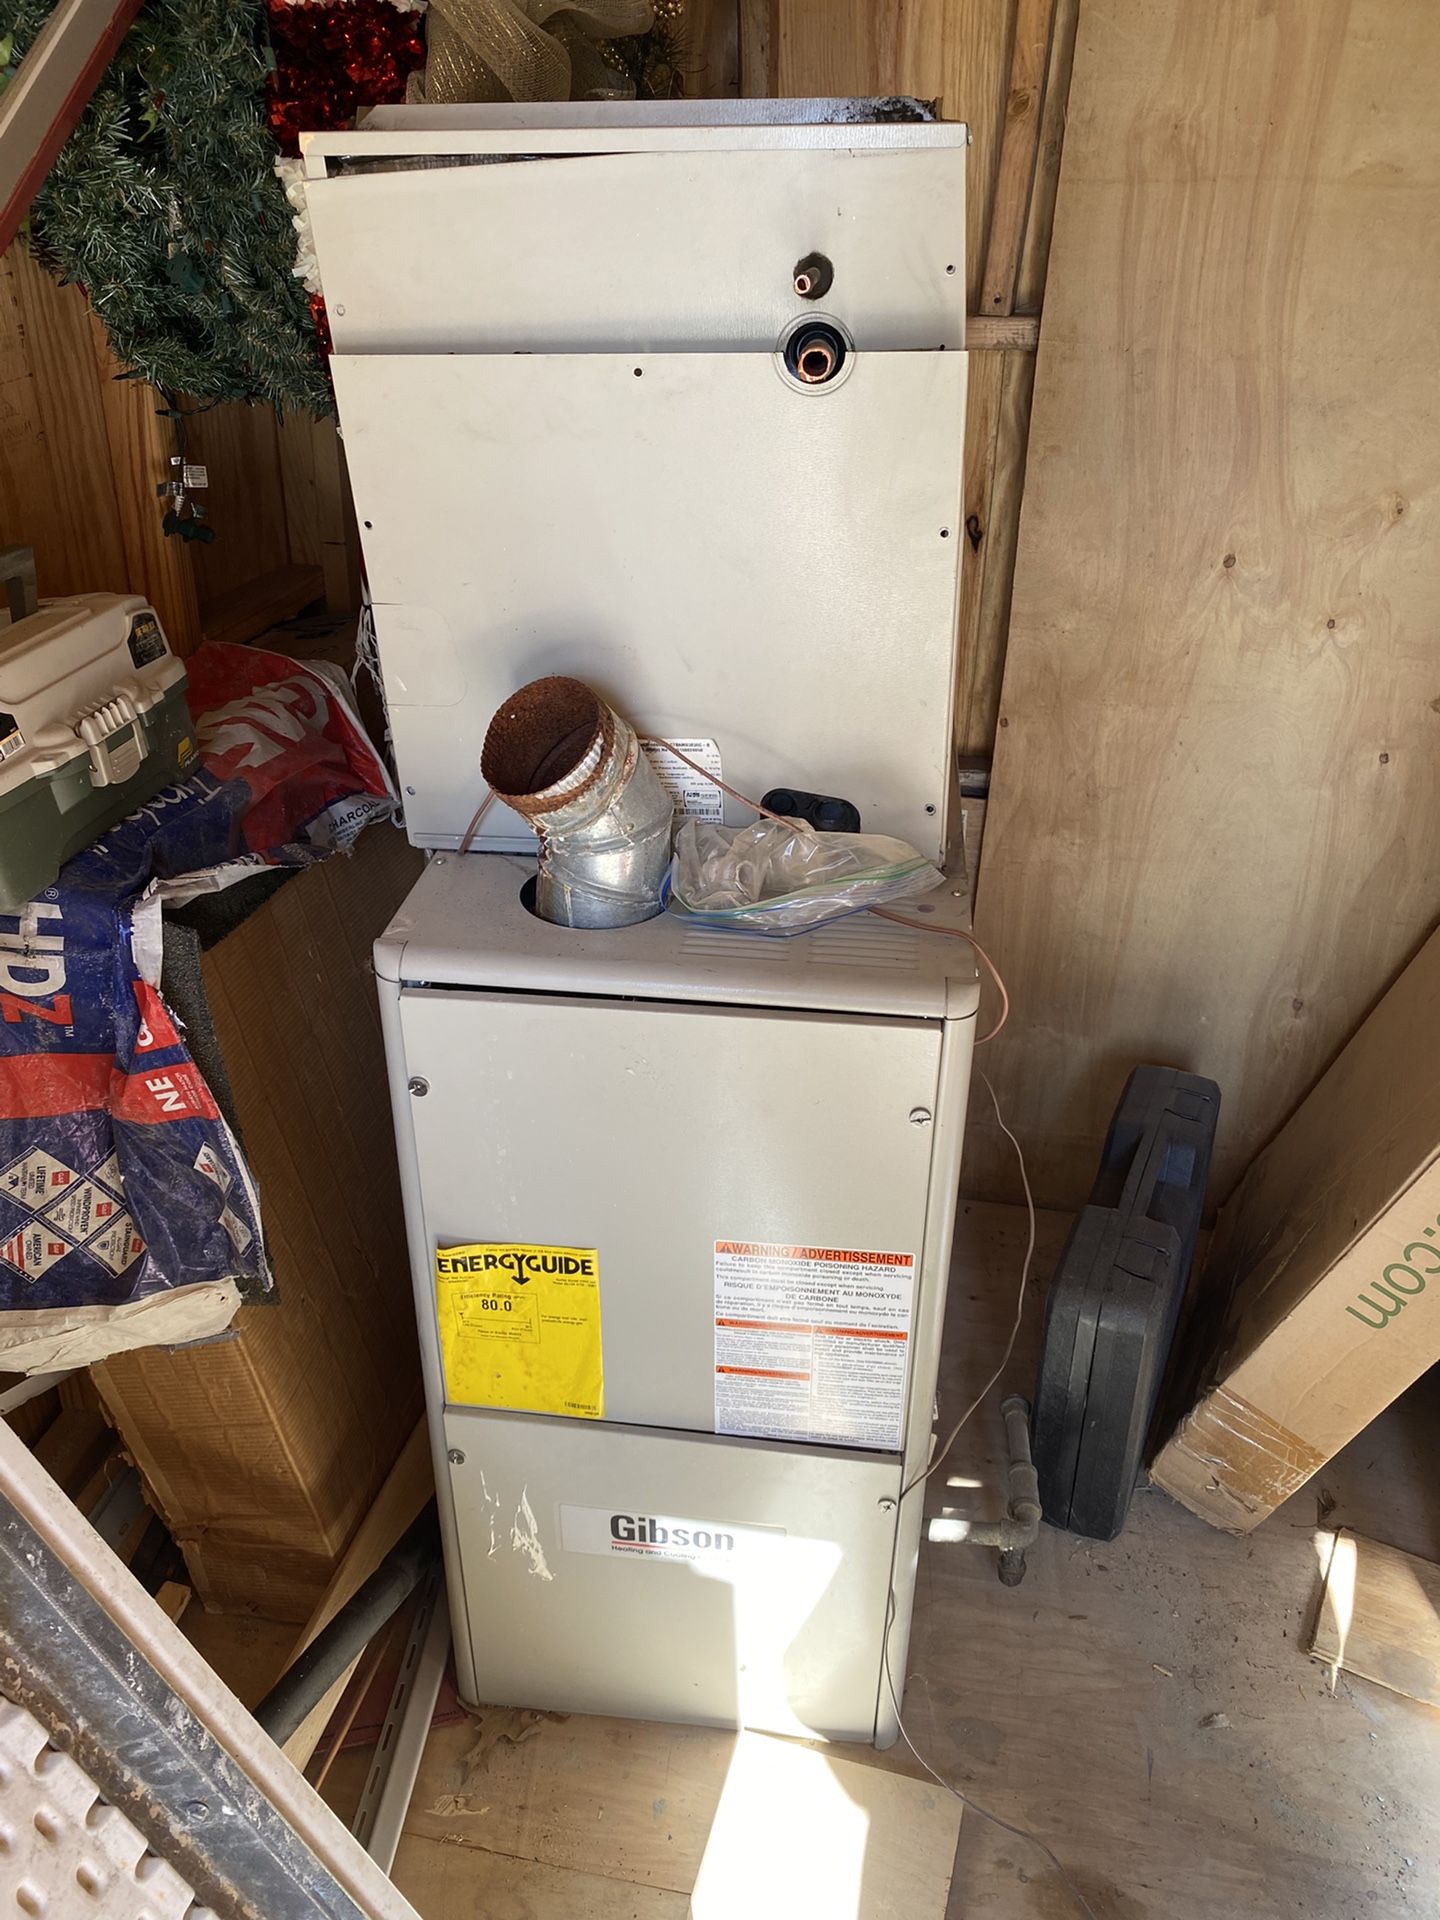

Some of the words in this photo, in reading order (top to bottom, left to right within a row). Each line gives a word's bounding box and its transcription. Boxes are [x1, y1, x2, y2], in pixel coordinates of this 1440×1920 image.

[35, 1166, 45, 1194] LIFETIME
[32, 1233, 42, 1266] AMERICAN
[732, 1244, 789, 1257] WARNING
[800, 1248, 910, 1265] ADVERTISSEMENT
[438, 1253, 594, 1276] ENERGYGUIDE
[731, 1255, 766, 1263] CARBON
[768, 1258, 811, 1266] MONOXIDE
[814, 1261, 859, 1270] POISONING
[861, 1264, 896, 1272] HAZARD
[1345, 1212, 1440, 1329] .com
[481, 1298, 512, 1312] 80.0
[798, 1294, 838, 1302] CARBONE
[855, 1291, 902, 1300] MONOXYDE
[610, 1514, 735, 1551] Gibson
[612, 1546, 643, 1555] Heating
